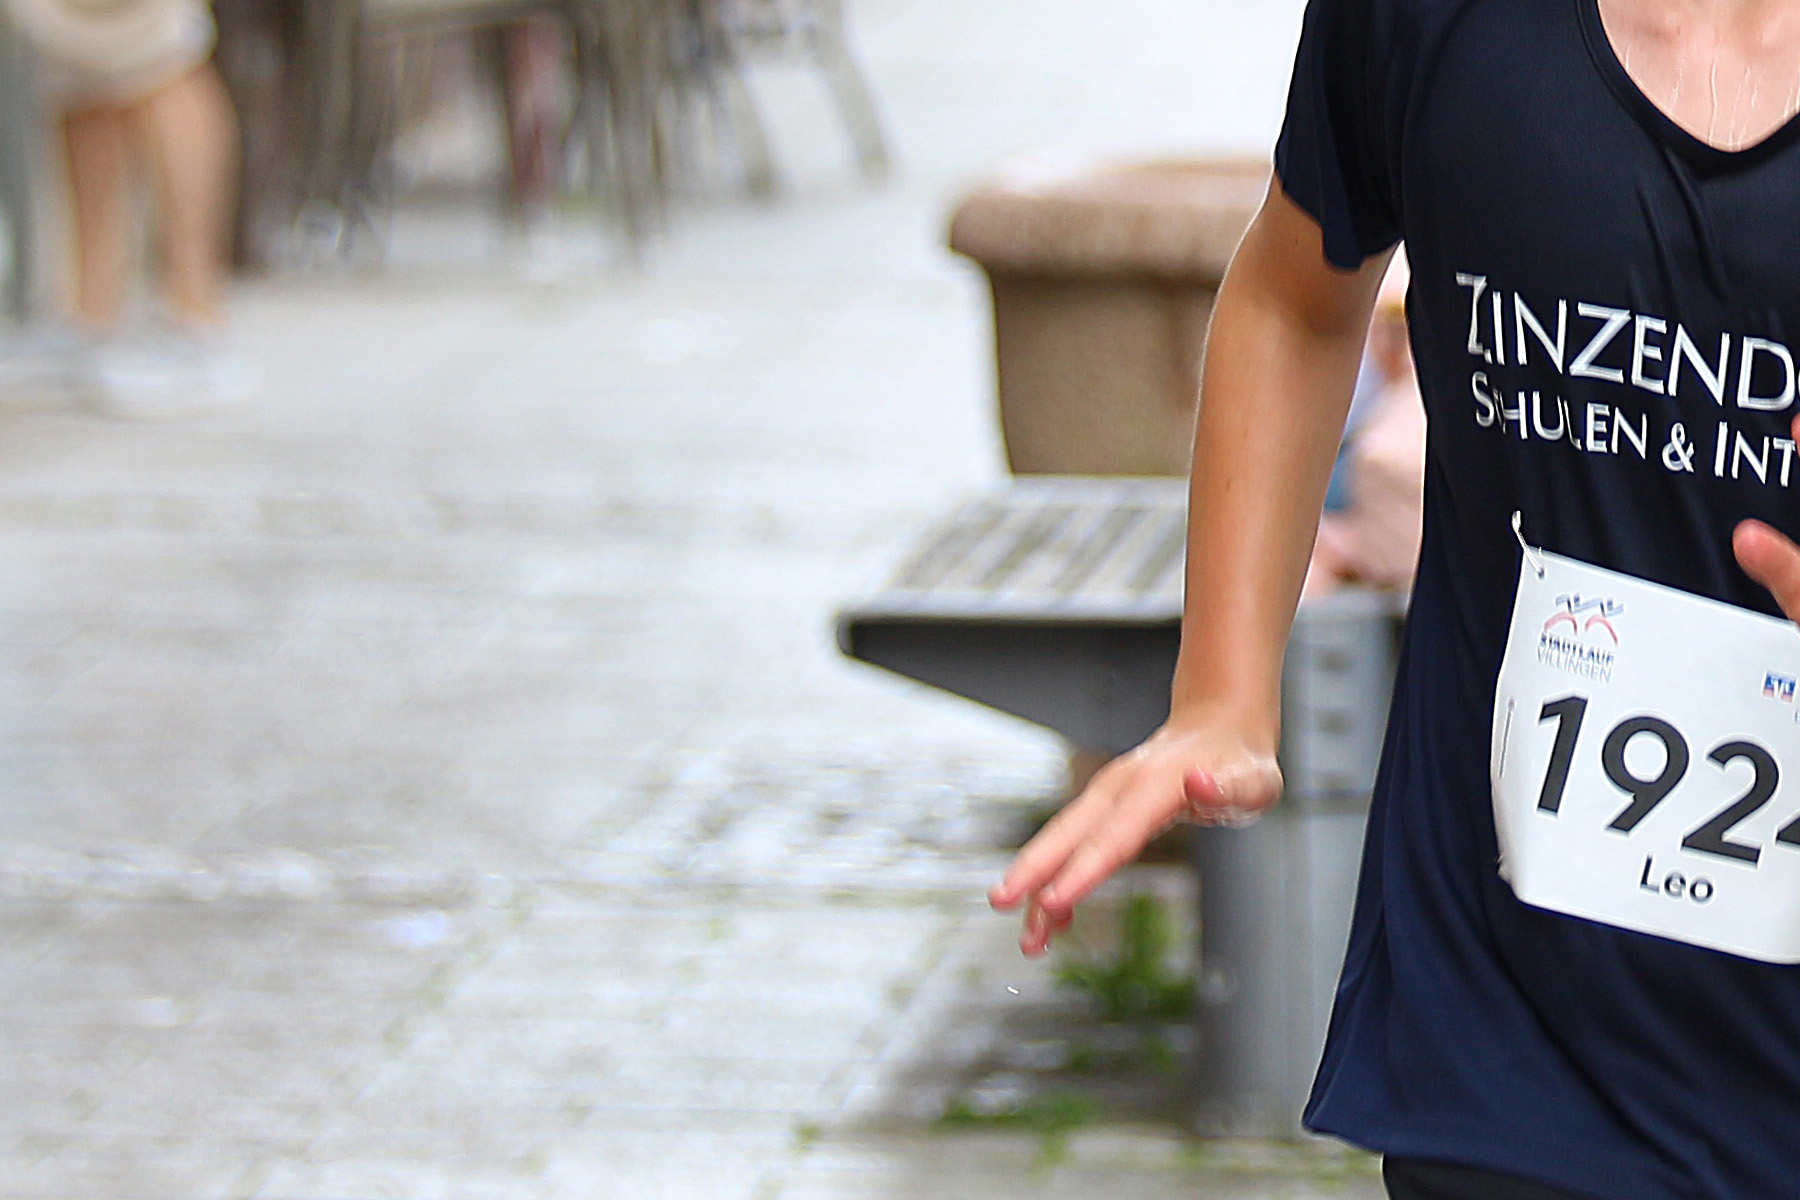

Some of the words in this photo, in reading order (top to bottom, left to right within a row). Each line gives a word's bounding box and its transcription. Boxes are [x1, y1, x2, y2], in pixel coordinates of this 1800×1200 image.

[1471, 370, 1648, 461] SHULEN
[1662, 421, 1695, 473] &
[1537, 646, 1613, 684] VILLINGEN
[1540, 633, 1615, 667] STADTLAUF
[1640, 854, 1714, 902] Leo
